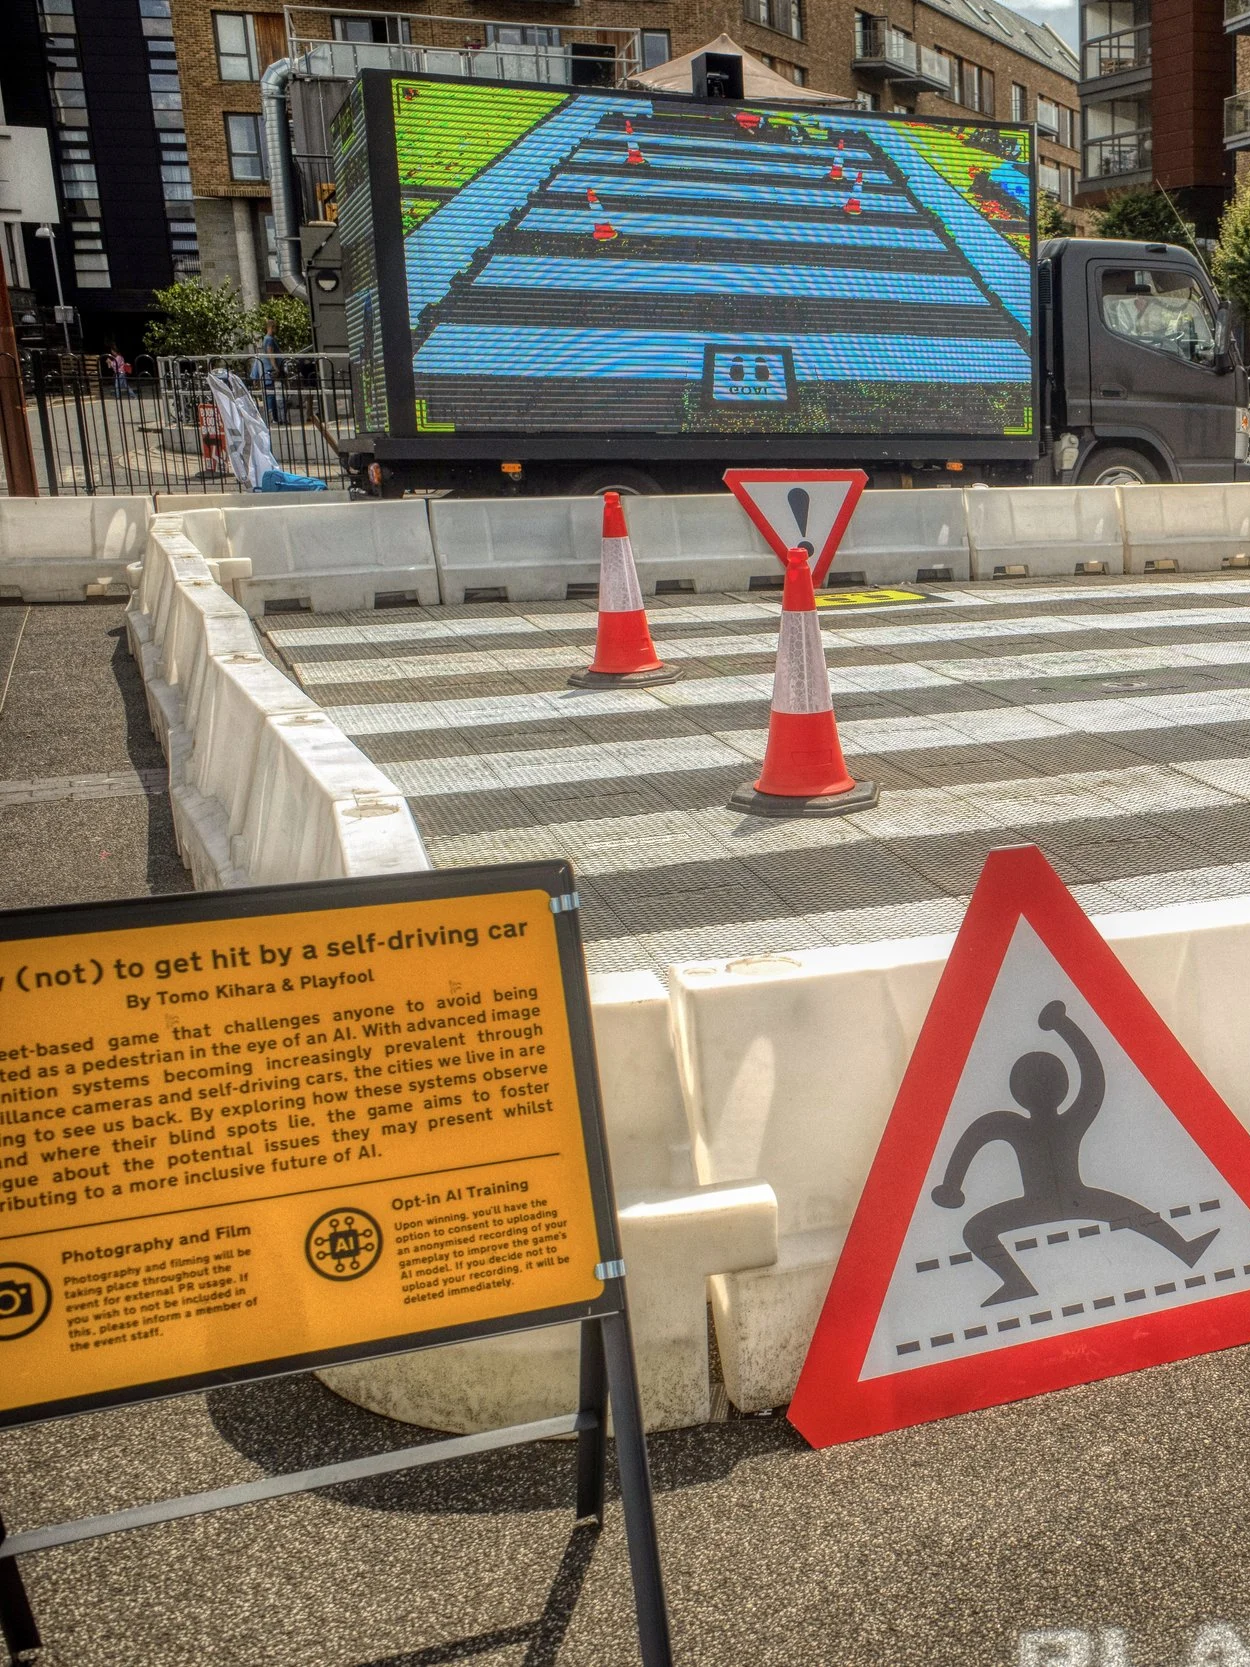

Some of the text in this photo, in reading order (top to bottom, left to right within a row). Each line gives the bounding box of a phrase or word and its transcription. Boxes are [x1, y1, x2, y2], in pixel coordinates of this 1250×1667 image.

[15, 958, 104, 992] (not)
[113, 958, 144, 980] to
[154, 951, 203, 980] get
[211, 946, 251, 970] hit
[259, 944, 293, 967] by
[301, 944, 318, 960] a
[326, 925, 479, 957] self-driving
[488, 921, 528, 940] car
[125, 968, 375, 1010] By Tomo Kihara & Playfool
[37, 1065, 60, 1078] as
[64, 1063, 76, 1075] a
[81, 1048, 185, 1075] pedestrian
[189, 1045, 206, 1060] in
[210, 1041, 242, 1056] the
[246, 1039, 277, 1054] eye
[282, 1032, 301, 1048] of
[306, 1032, 327, 1045] an
[332, 1026, 357, 1042] AI.
[361, 1020, 402, 1038] With
[406, 1009, 487, 1033] advanced
[491, 1006, 540, 1022] image
[107, 1032, 160, 1051] game
[171, 1023, 212, 1041] that
[223, 1013, 320, 1035] challenges
[332, 1004, 395, 1022] anyone
[405, 999, 425, 1013] to
[436, 991, 482, 1009] avoid
[492, 986, 538, 1002] being
[71, 1095, 153, 1116] cameras
[158, 1086, 192, 1105] and
[197, 1075, 301, 1100] self-driving
[353, 1064, 383, 1079] the
[387, 1058, 433, 1075] cities
[437, 1055, 461, 1068] we
[465, 1050, 495, 1064] live
[499, 1046, 514, 1060] in
[519, 1044, 546, 1057] are
[72, 1074, 150, 1097] systems
[163, 1061, 253, 1083] becoming
[265, 1044, 372, 1071] increasingly
[384, 1032, 466, 1058] prevalent
[476, 1023, 543, 1043] through
[33, 1128, 55, 1143] to
[62, 1124, 96, 1139] see
[102, 1120, 125, 1133] us
[131, 1110, 183, 1129] back.
[190, 1106, 214, 1122] By
[220, 1095, 306, 1117] exploring
[312, 1090, 348, 1105] how
[354, 1083, 403, 1099] these
[408, 1073, 477, 1093] systems
[482, 1063, 548, 1082] observe
[40, 1144, 100, 1163] where
[111, 1134, 157, 1153] their
[168, 1125, 216, 1145] blind
[226, 1118, 278, 1139] spots
[326, 1108, 356, 1123] the
[367, 1101, 413, 1120] game
[423, 1094, 462, 1110] aims
[471, 1089, 490, 1103] to
[499, 1082, 550, 1099] foster
[0, 1098, 554, 1193] gue about the potential issues they may present whilst
[83, 1185, 105, 1200] to
[111, 1184, 123, 1196] a
[129, 1175, 179, 1193] more
[184, 1163, 265, 1185] inclusive
[270, 1154, 327, 1172] future
[332, 1147, 351, 1163] of
[357, 1143, 382, 1160] AI.
[391, 1180, 529, 1211] Opt-in AI Training
[61, 1224, 251, 1265] Photography and Film
[335, 1236, 356, 1253] AI
